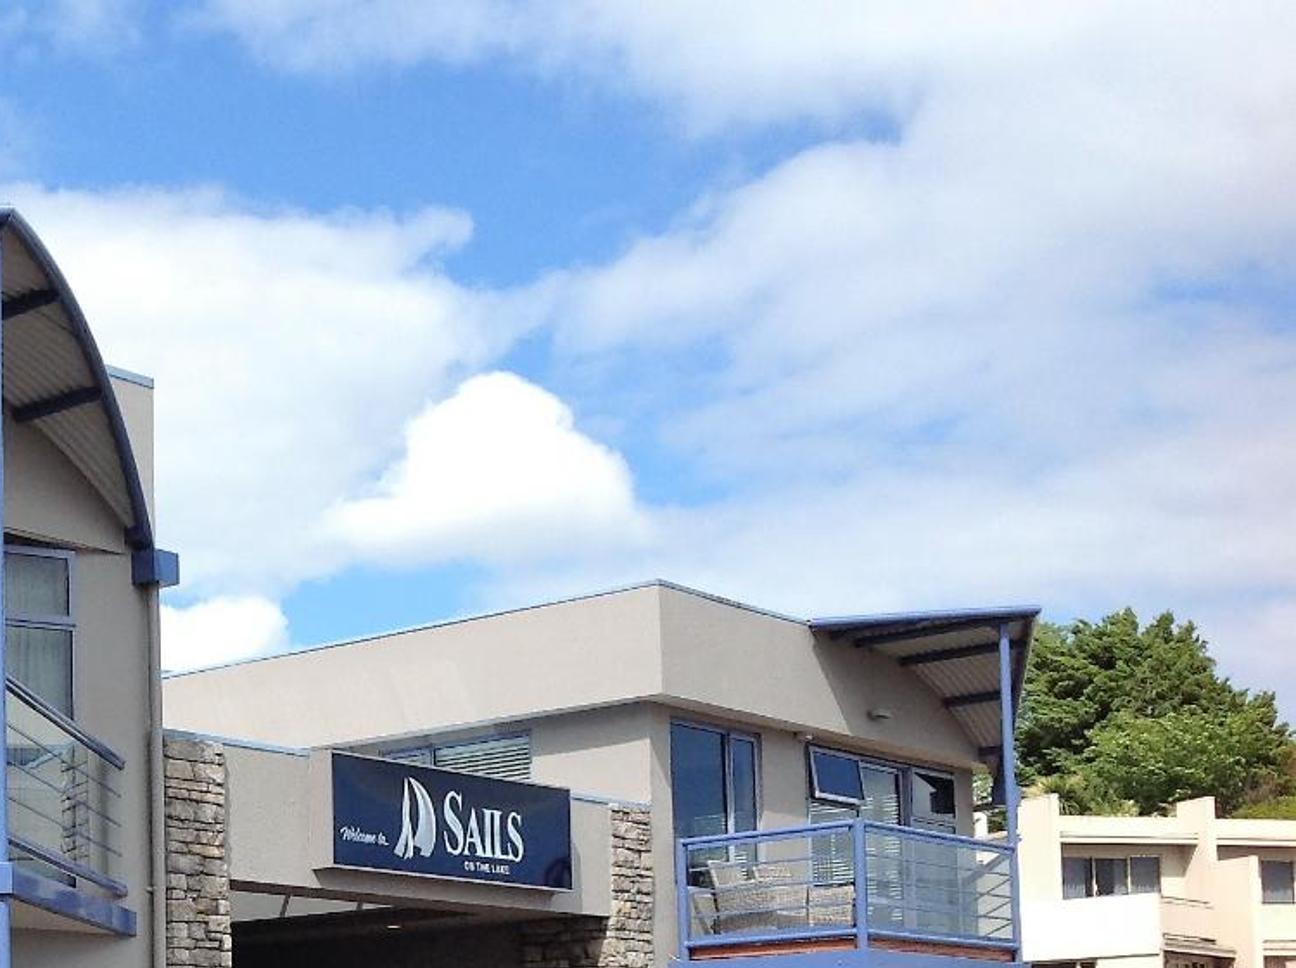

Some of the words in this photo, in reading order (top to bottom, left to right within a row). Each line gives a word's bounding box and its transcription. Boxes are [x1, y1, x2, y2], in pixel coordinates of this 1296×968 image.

[443, 790, 525, 863] SAILS
[475, 861, 491, 873] THE
[491, 863, 510, 875] LAKE
